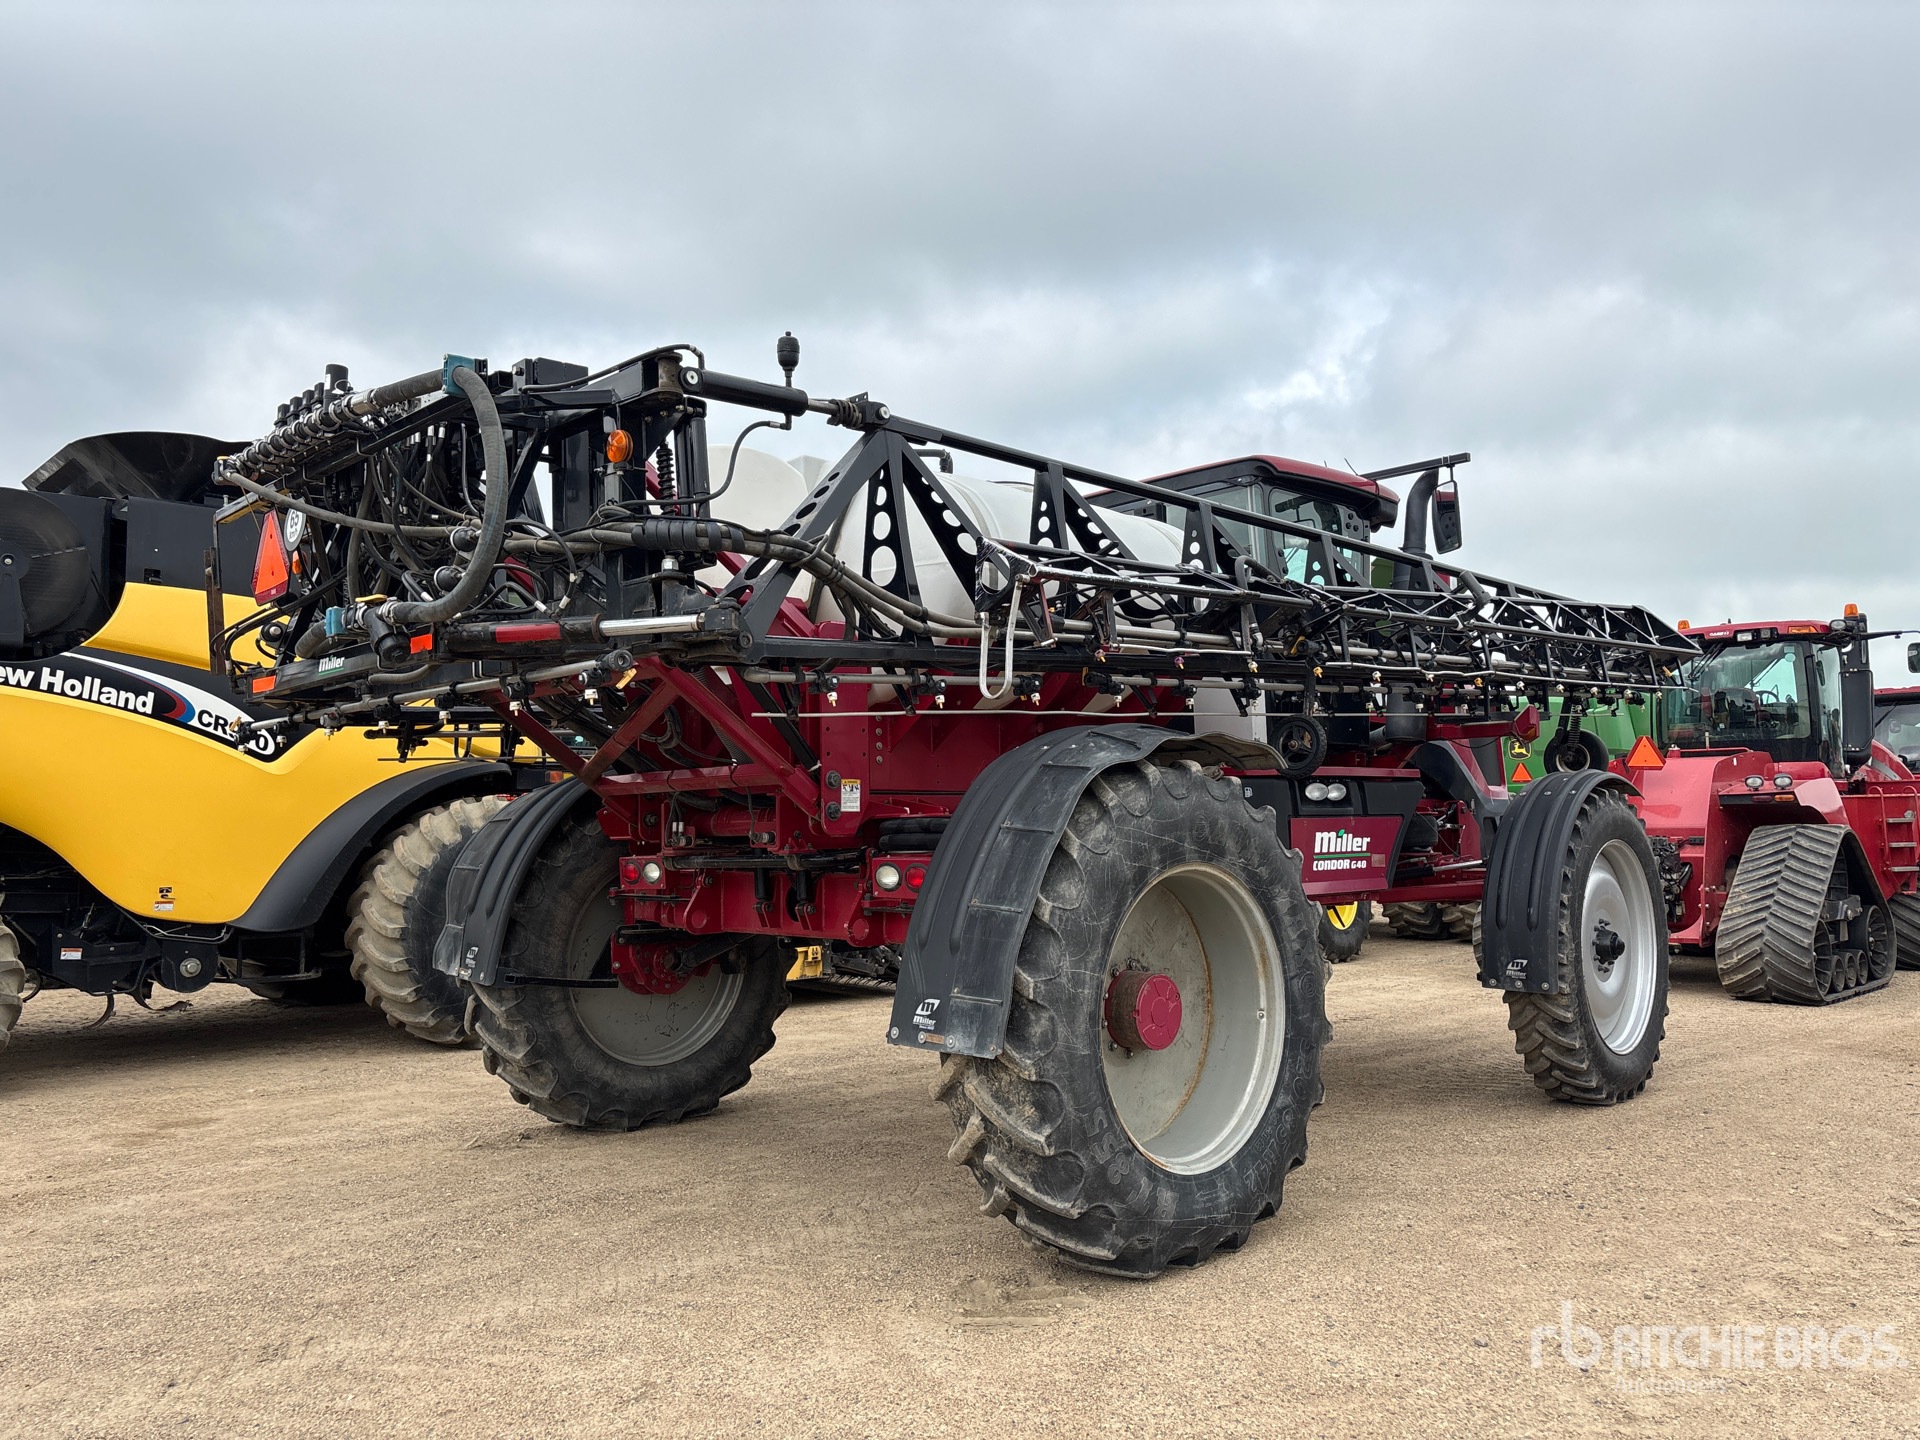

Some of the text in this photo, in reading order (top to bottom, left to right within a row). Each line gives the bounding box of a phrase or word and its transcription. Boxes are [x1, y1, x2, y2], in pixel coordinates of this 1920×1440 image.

[319, 656, 345, 672] Miller
[39, 666, 154, 715] Holland
[1314, 829, 1371, 853] Miller
[1351, 860, 1367, 869] G40
